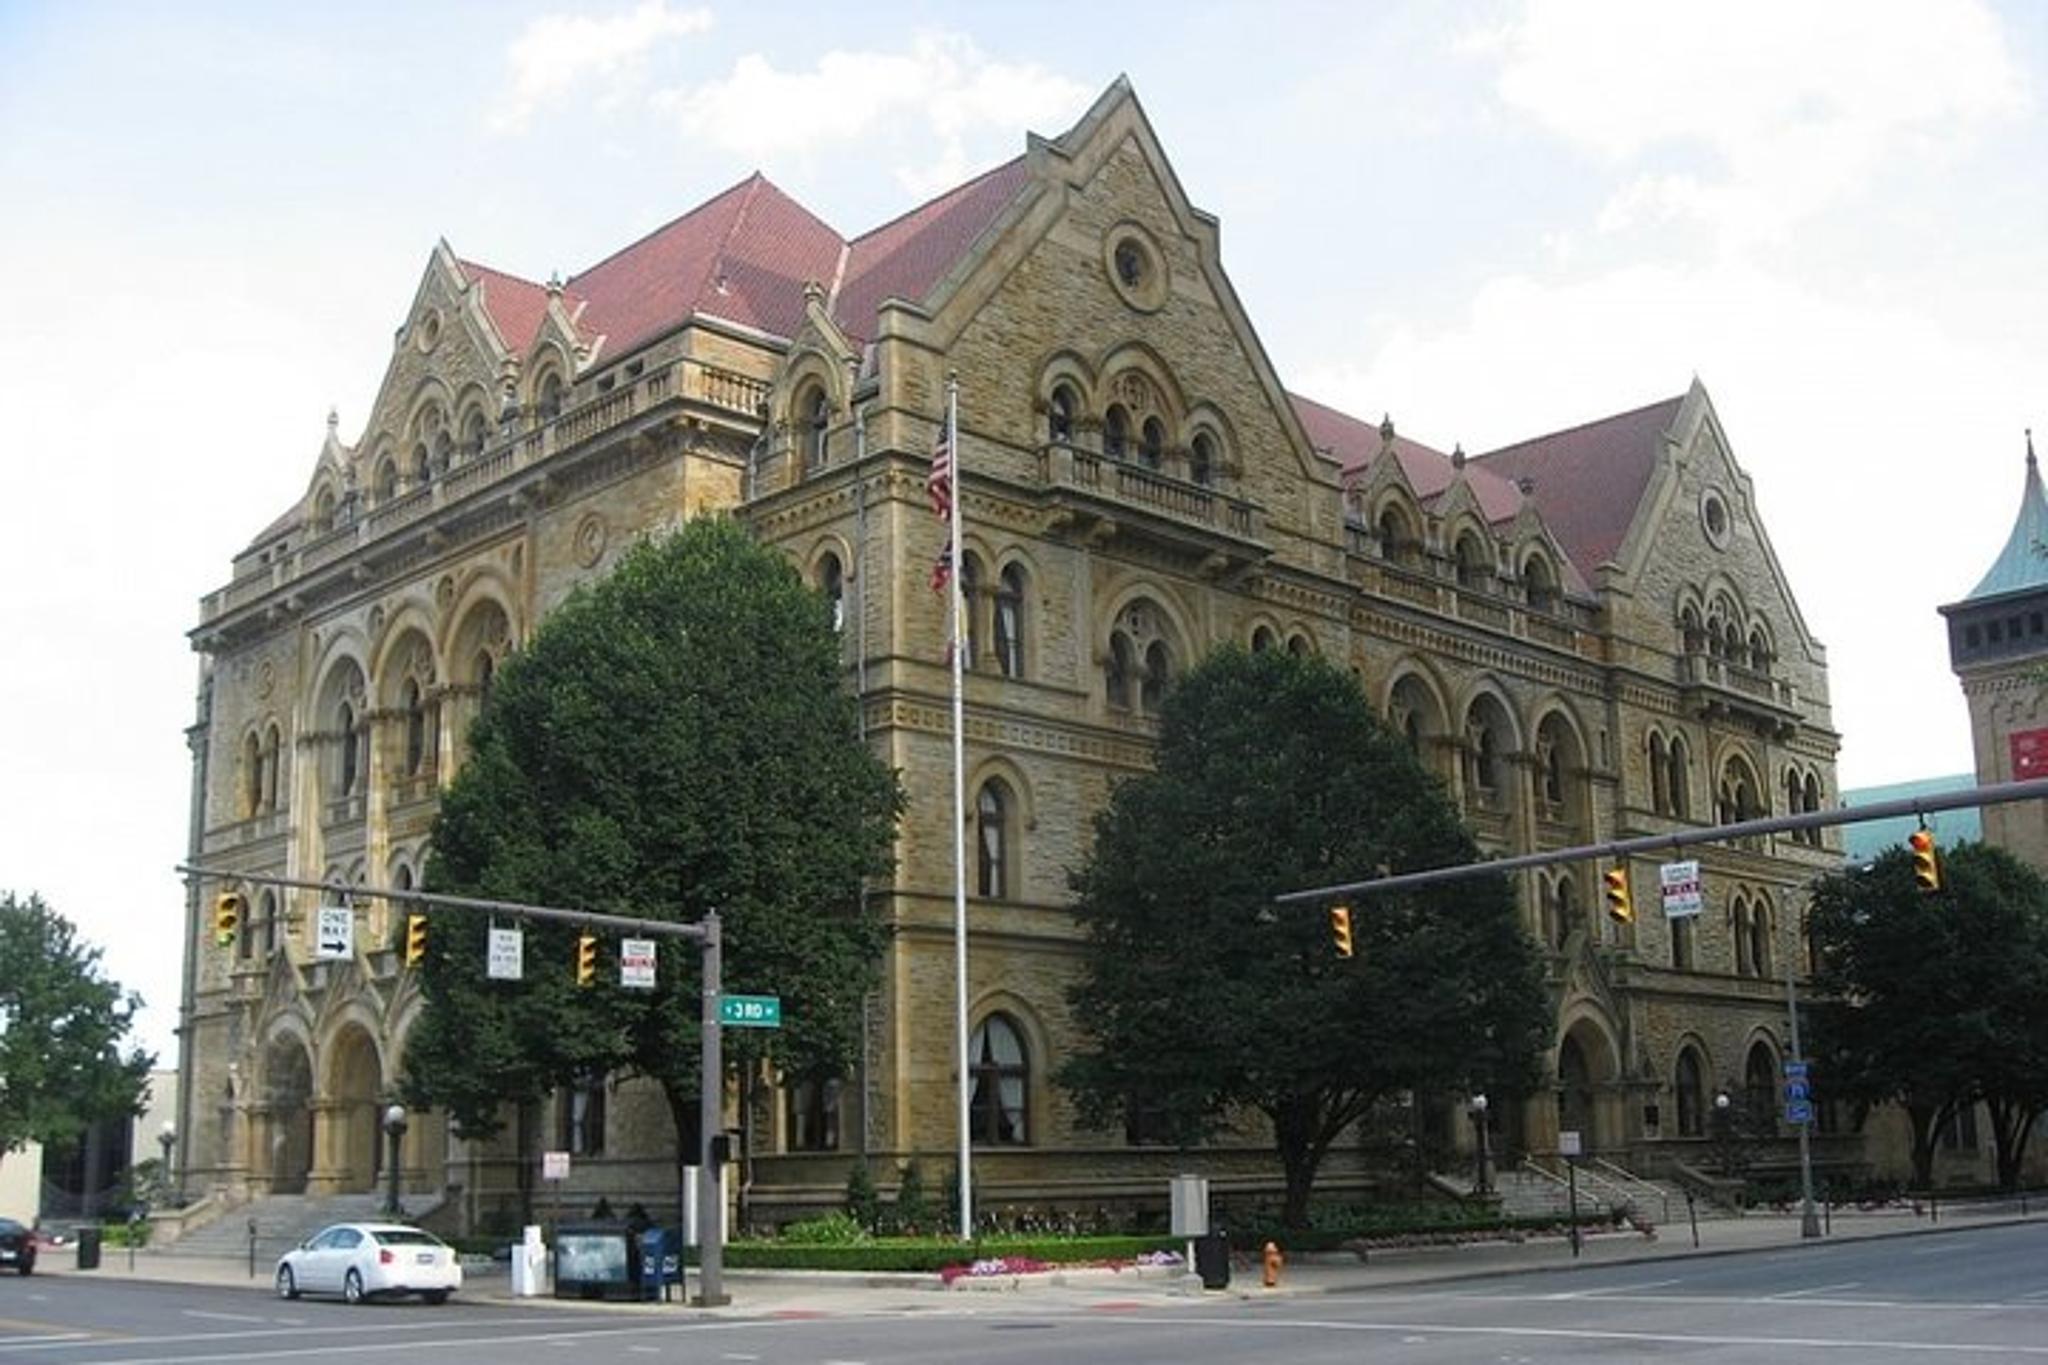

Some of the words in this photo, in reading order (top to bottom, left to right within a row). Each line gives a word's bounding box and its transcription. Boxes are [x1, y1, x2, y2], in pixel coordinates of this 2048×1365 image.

[322, 911, 348, 924] ONE
[322, 926, 348, 937] WAY
[733, 1001, 763, 1019] 3RD
